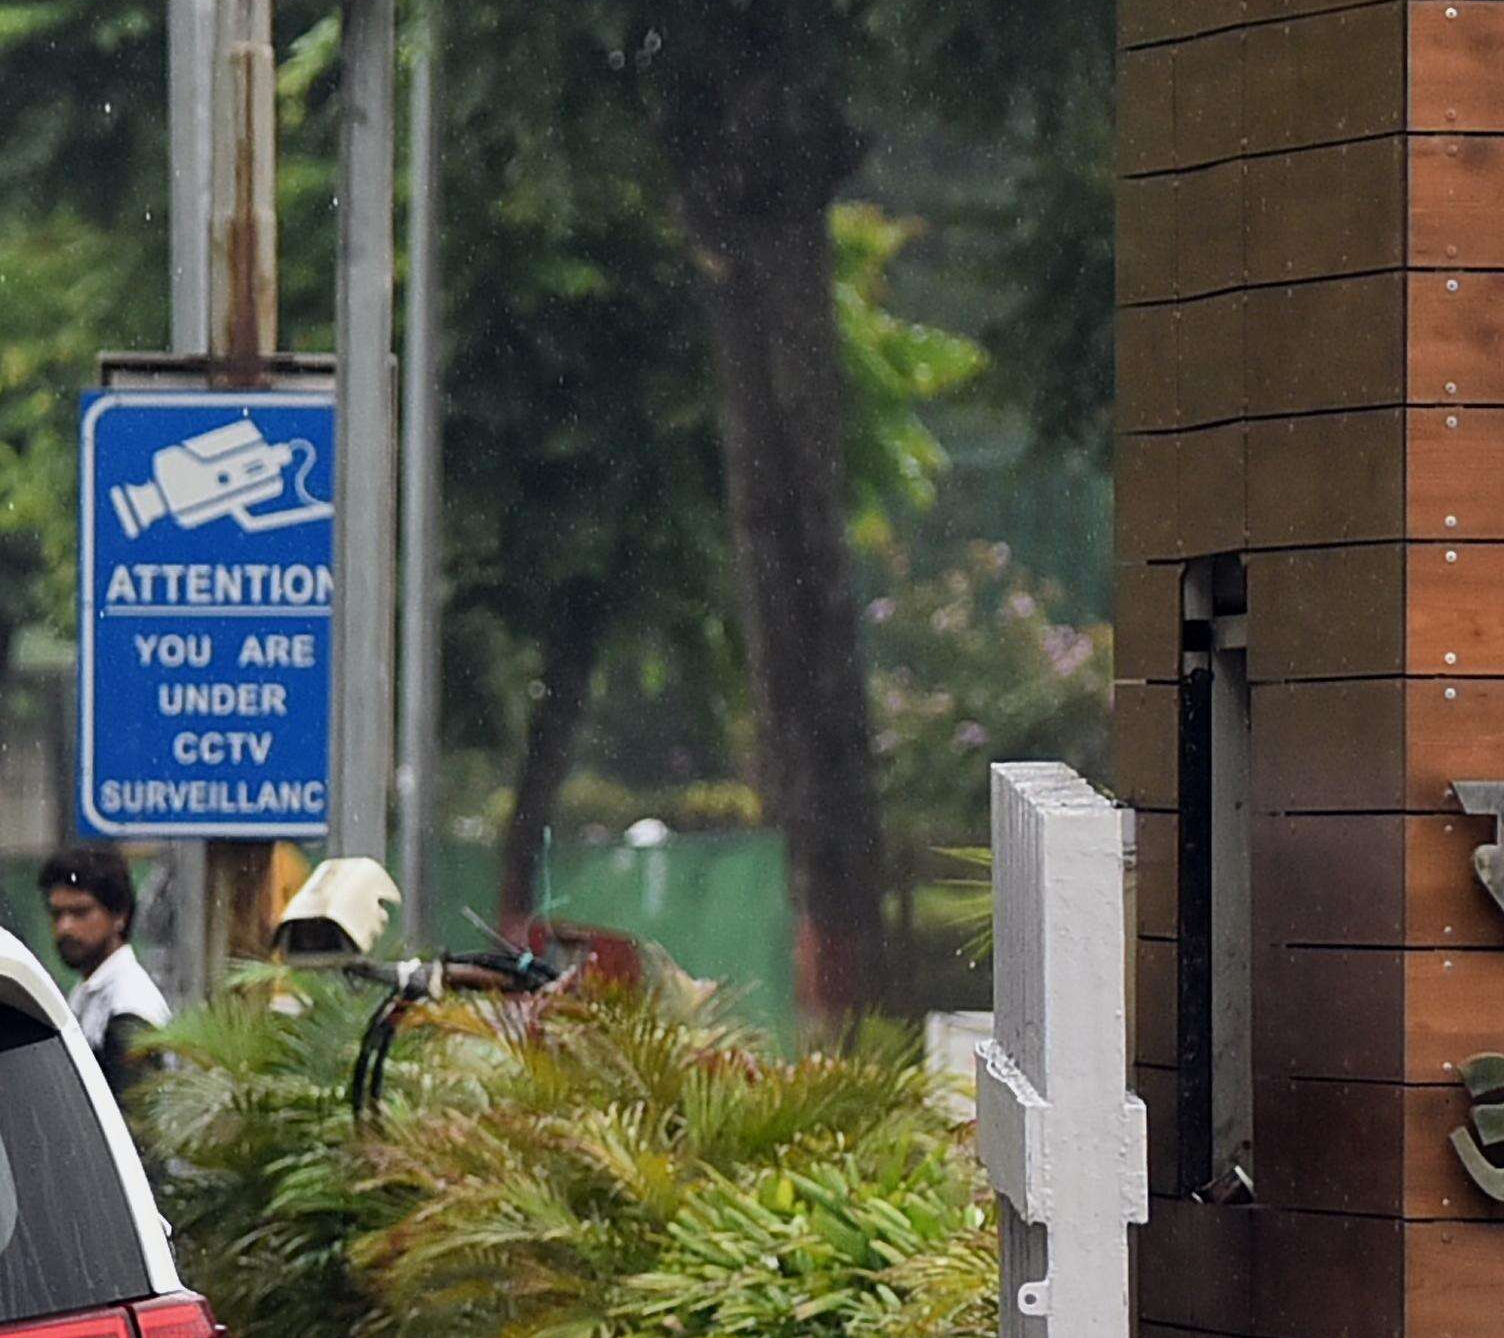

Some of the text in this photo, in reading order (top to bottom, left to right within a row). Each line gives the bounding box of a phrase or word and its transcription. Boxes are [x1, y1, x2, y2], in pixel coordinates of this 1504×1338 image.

[135, 634, 316, 669] YOU ARE
[158, 682, 287, 717] UNDER
[173, 730, 273, 765] CCTV
[99, 779, 330, 814] SURVEILLANC
